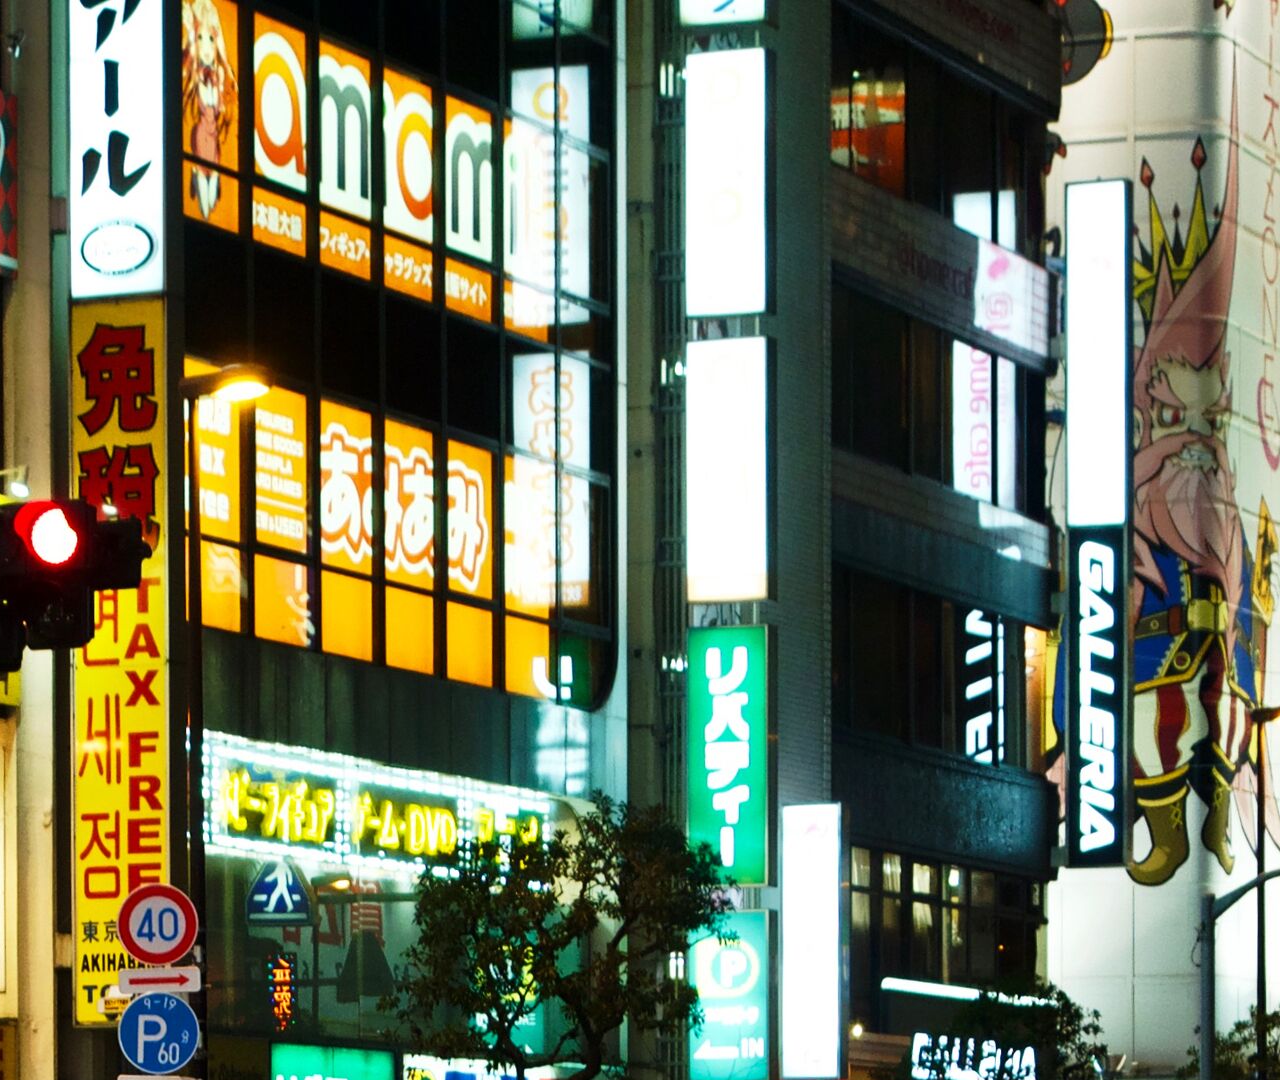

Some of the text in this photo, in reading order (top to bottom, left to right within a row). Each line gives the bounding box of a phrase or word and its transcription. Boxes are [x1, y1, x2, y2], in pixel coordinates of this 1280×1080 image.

[123, 576, 162, 708] TAX
[1078, 540, 1117, 853] GALLERIA
[704, 645, 750, 868] リバティー
[136, 907, 180, 942] 40
[158, 1042, 180, 1065] 60
[740, 1036, 766, 1059] IN
